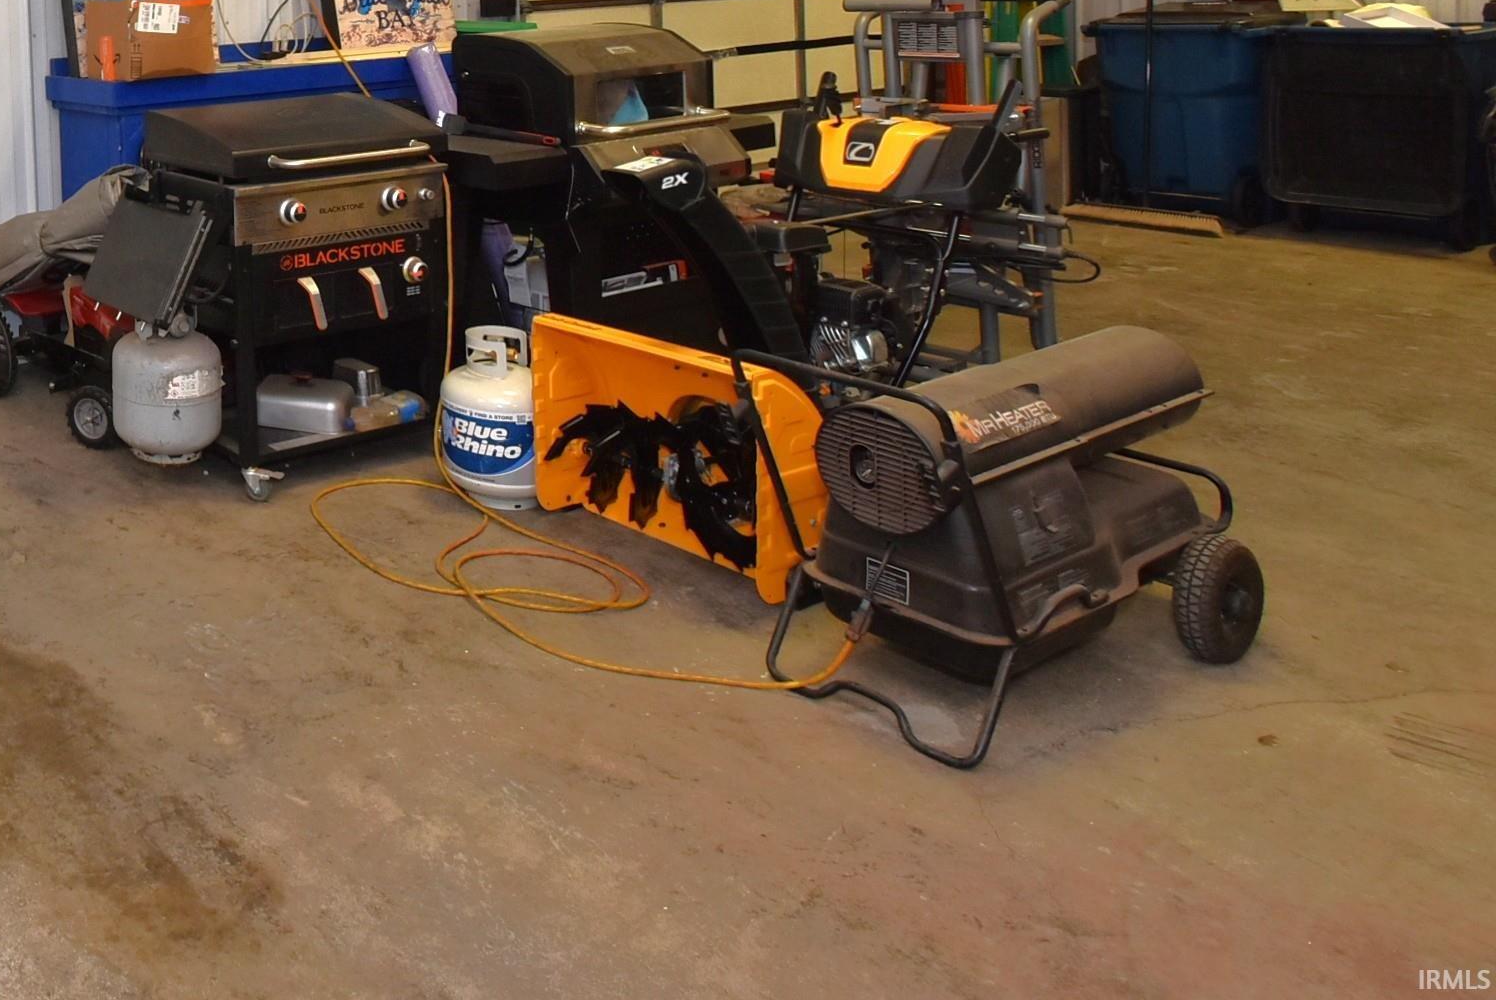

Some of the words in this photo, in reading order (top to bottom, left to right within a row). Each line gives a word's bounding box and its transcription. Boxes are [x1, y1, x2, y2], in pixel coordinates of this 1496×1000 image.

[661, 171, 689, 190] 2X
[319, 202, 365, 215] BLACKSTONE
[294, 238, 406, 269] BLACKSTONE
[454, 417, 508, 441] Blue
[451, 434, 523, 460] Rhino
